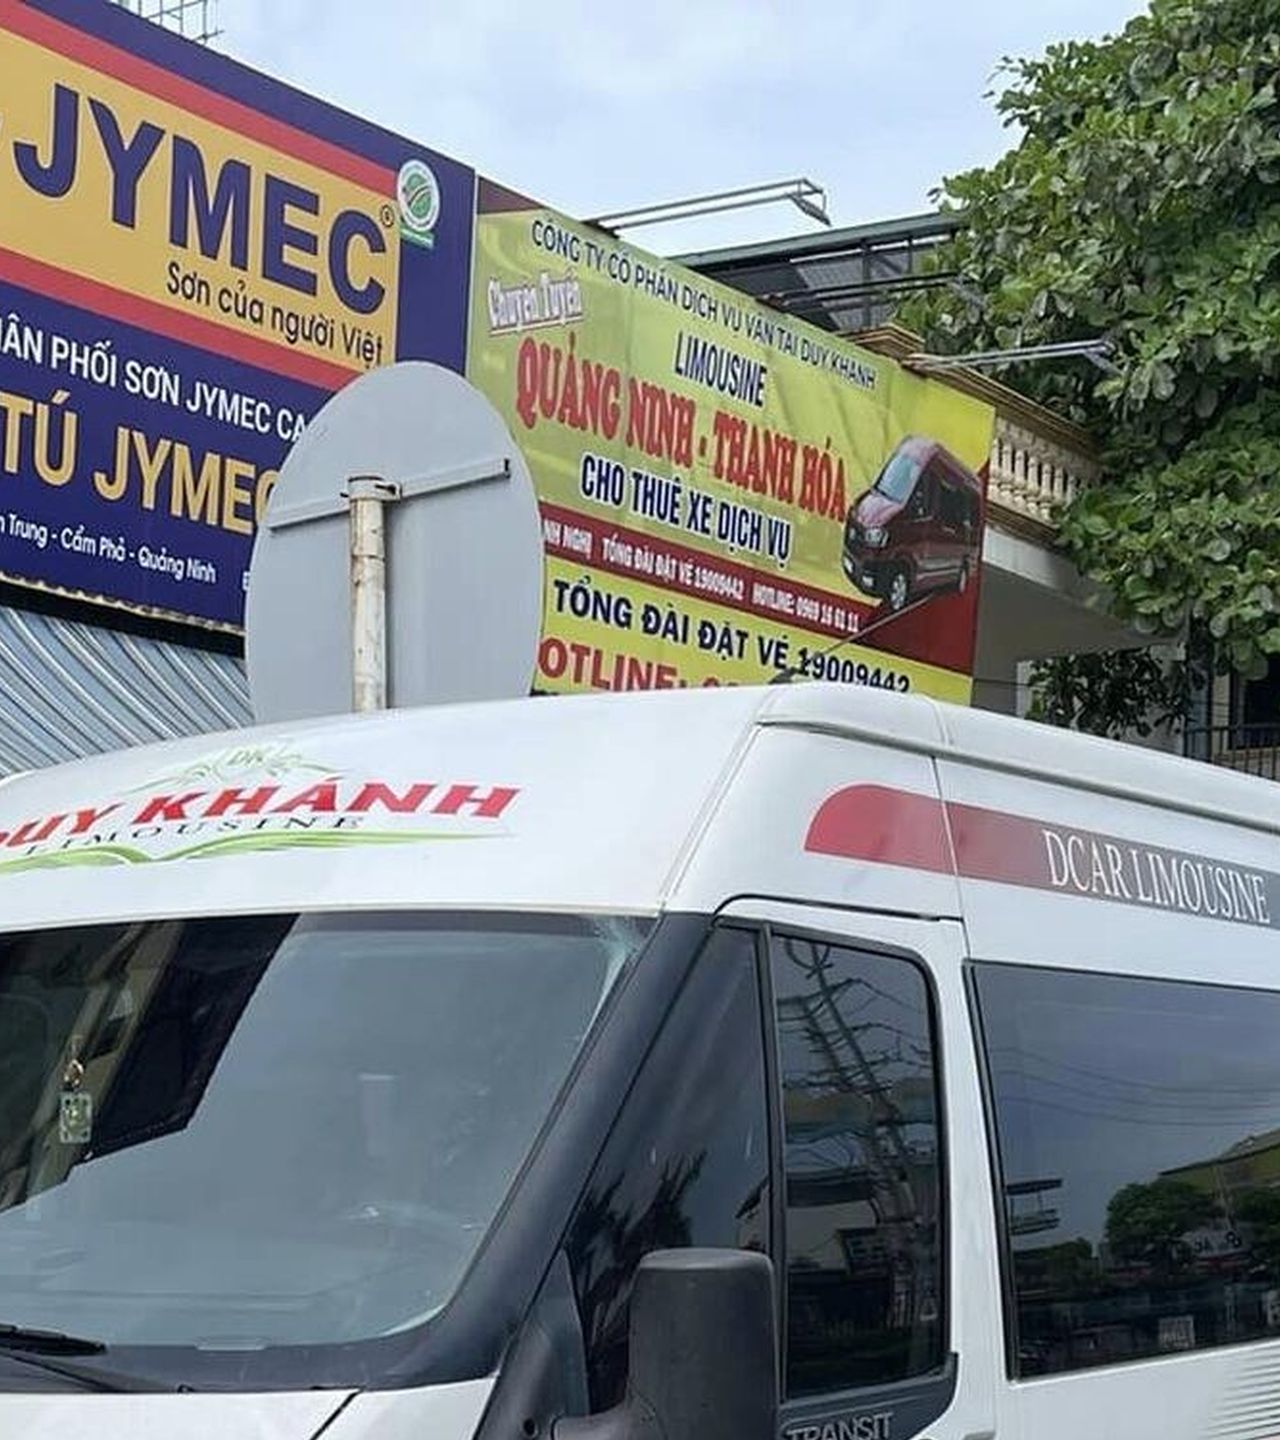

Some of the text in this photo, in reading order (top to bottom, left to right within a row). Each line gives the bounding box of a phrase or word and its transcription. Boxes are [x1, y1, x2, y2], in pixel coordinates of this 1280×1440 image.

[13, 84, 387, 314] JYMEC
[167, 262, 383, 369] Sơn của người Việt
[585, 241, 604, 271] TY
[801, 338, 829, 366] DUY
[51, 335, 117, 388] PHỐI
[124, 360, 180, 406] SƠN
[186, 382, 271, 433] JYMEC
[277, 408, 308, 442] CA
[675, 330, 767, 407] LIMOUSINE
[516, 332, 621, 440] QUẢNG
[626, 378, 695, 469] NINH
[713, 411, 798, 504] THANH
[799, 437, 846, 522] HÓA
[9, 514, 48, 548] Trung
[61, 525, 96, 556] Cẩm
[138, 547, 185, 581] Quảng
[187, 558, 216, 584] Ninh
[581, 455, 790, 568] CHO THUÊ XE DỊCH VỤ
[538, 637, 687, 691] OTLINE:
[554, 575, 632, 629] TỔNG
[642, 603, 689, 644] ĐÀI
[697, 621, 749, 661] ĐẶT
[758, 635, 788, 669] VÉ
[25, 815, 365, 856] LIMOUSINE
[132, 776, 522, 824] KHÁNH
[1042, 829, 1270, 924] DCAR LIMOUSINE
